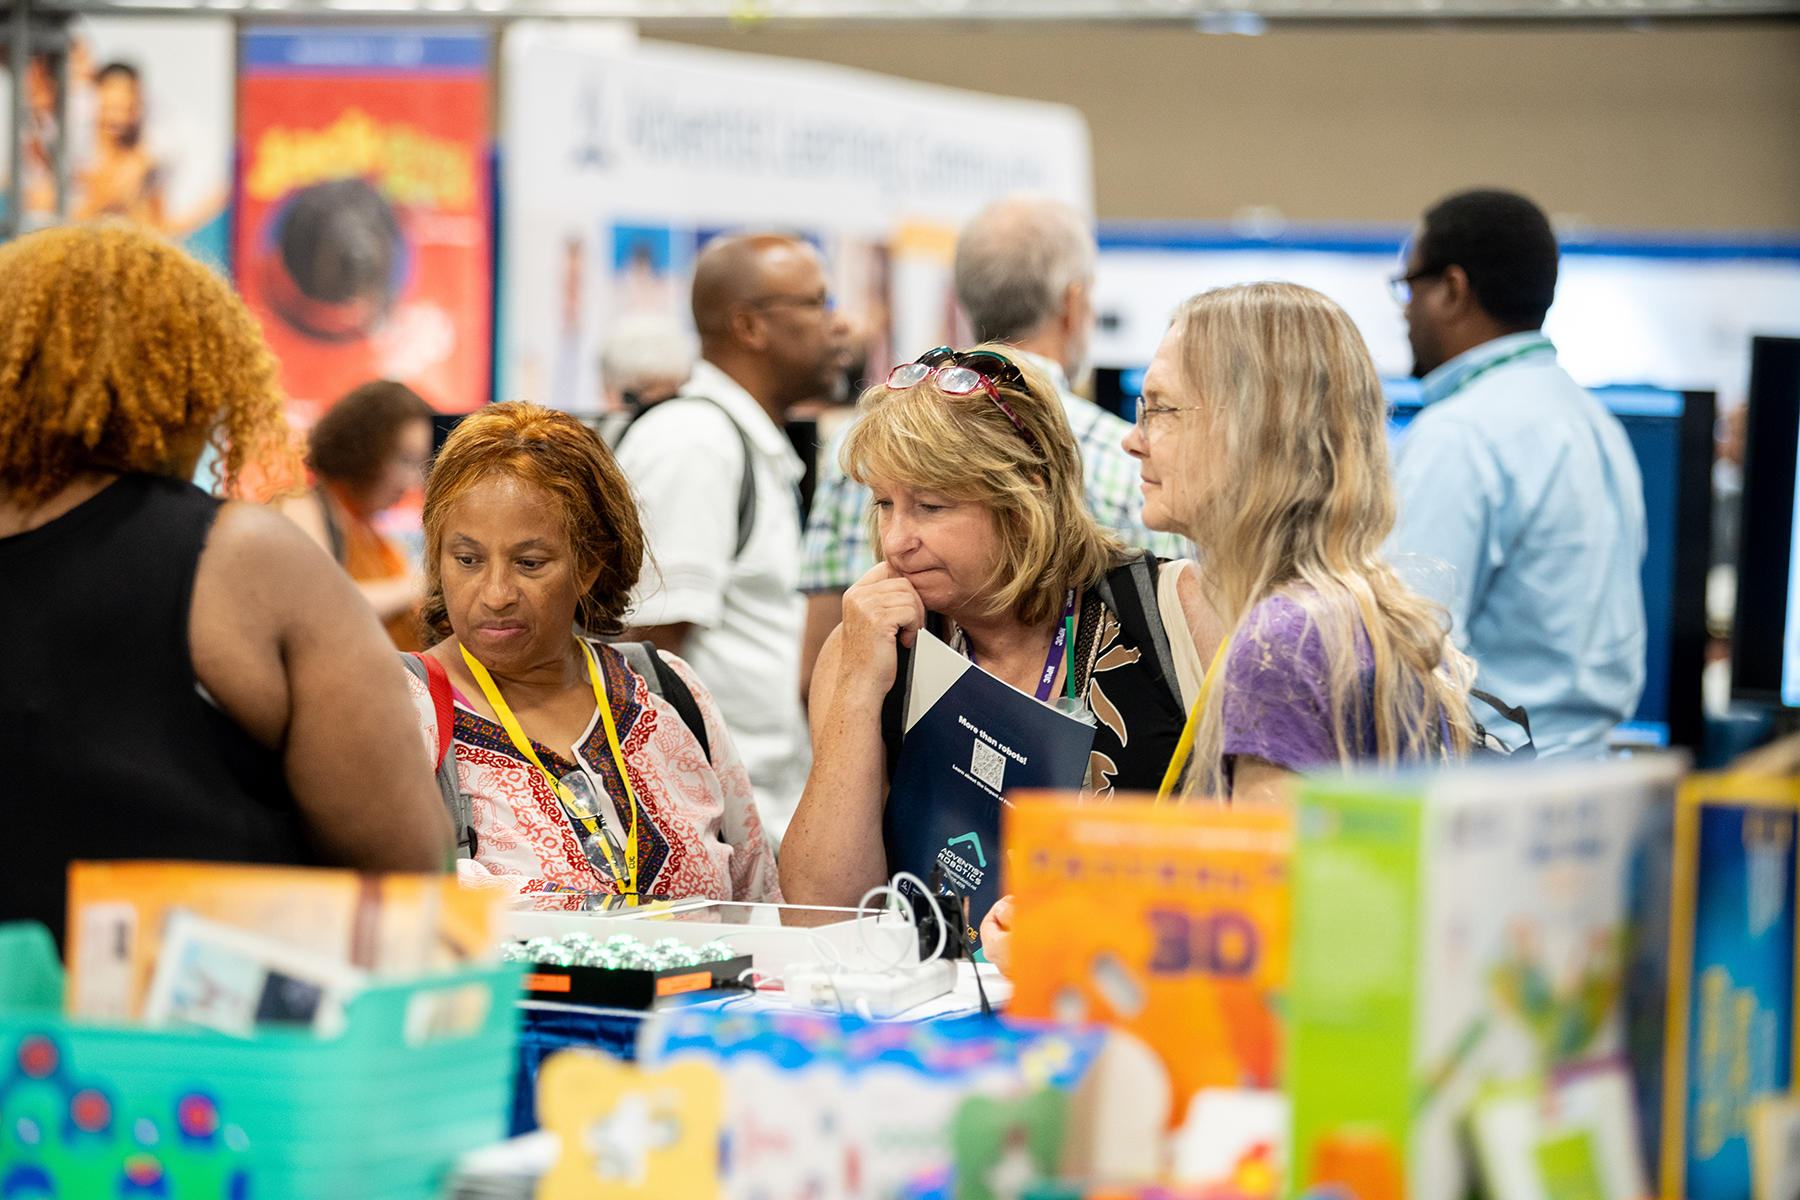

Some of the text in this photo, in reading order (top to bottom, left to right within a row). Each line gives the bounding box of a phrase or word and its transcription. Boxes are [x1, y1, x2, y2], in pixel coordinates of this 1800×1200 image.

[1054, 627, 1066, 647] NPUC
[1042, 665, 1056, 684] NPUC
[958, 715, 1028, 766] More than robots!
[952, 764, 965, 776] Learn
[628, 855, 636, 869] CUC
[937, 852, 982, 885] ROBOTICS
[940, 847, 985, 878] ADVENTIST
